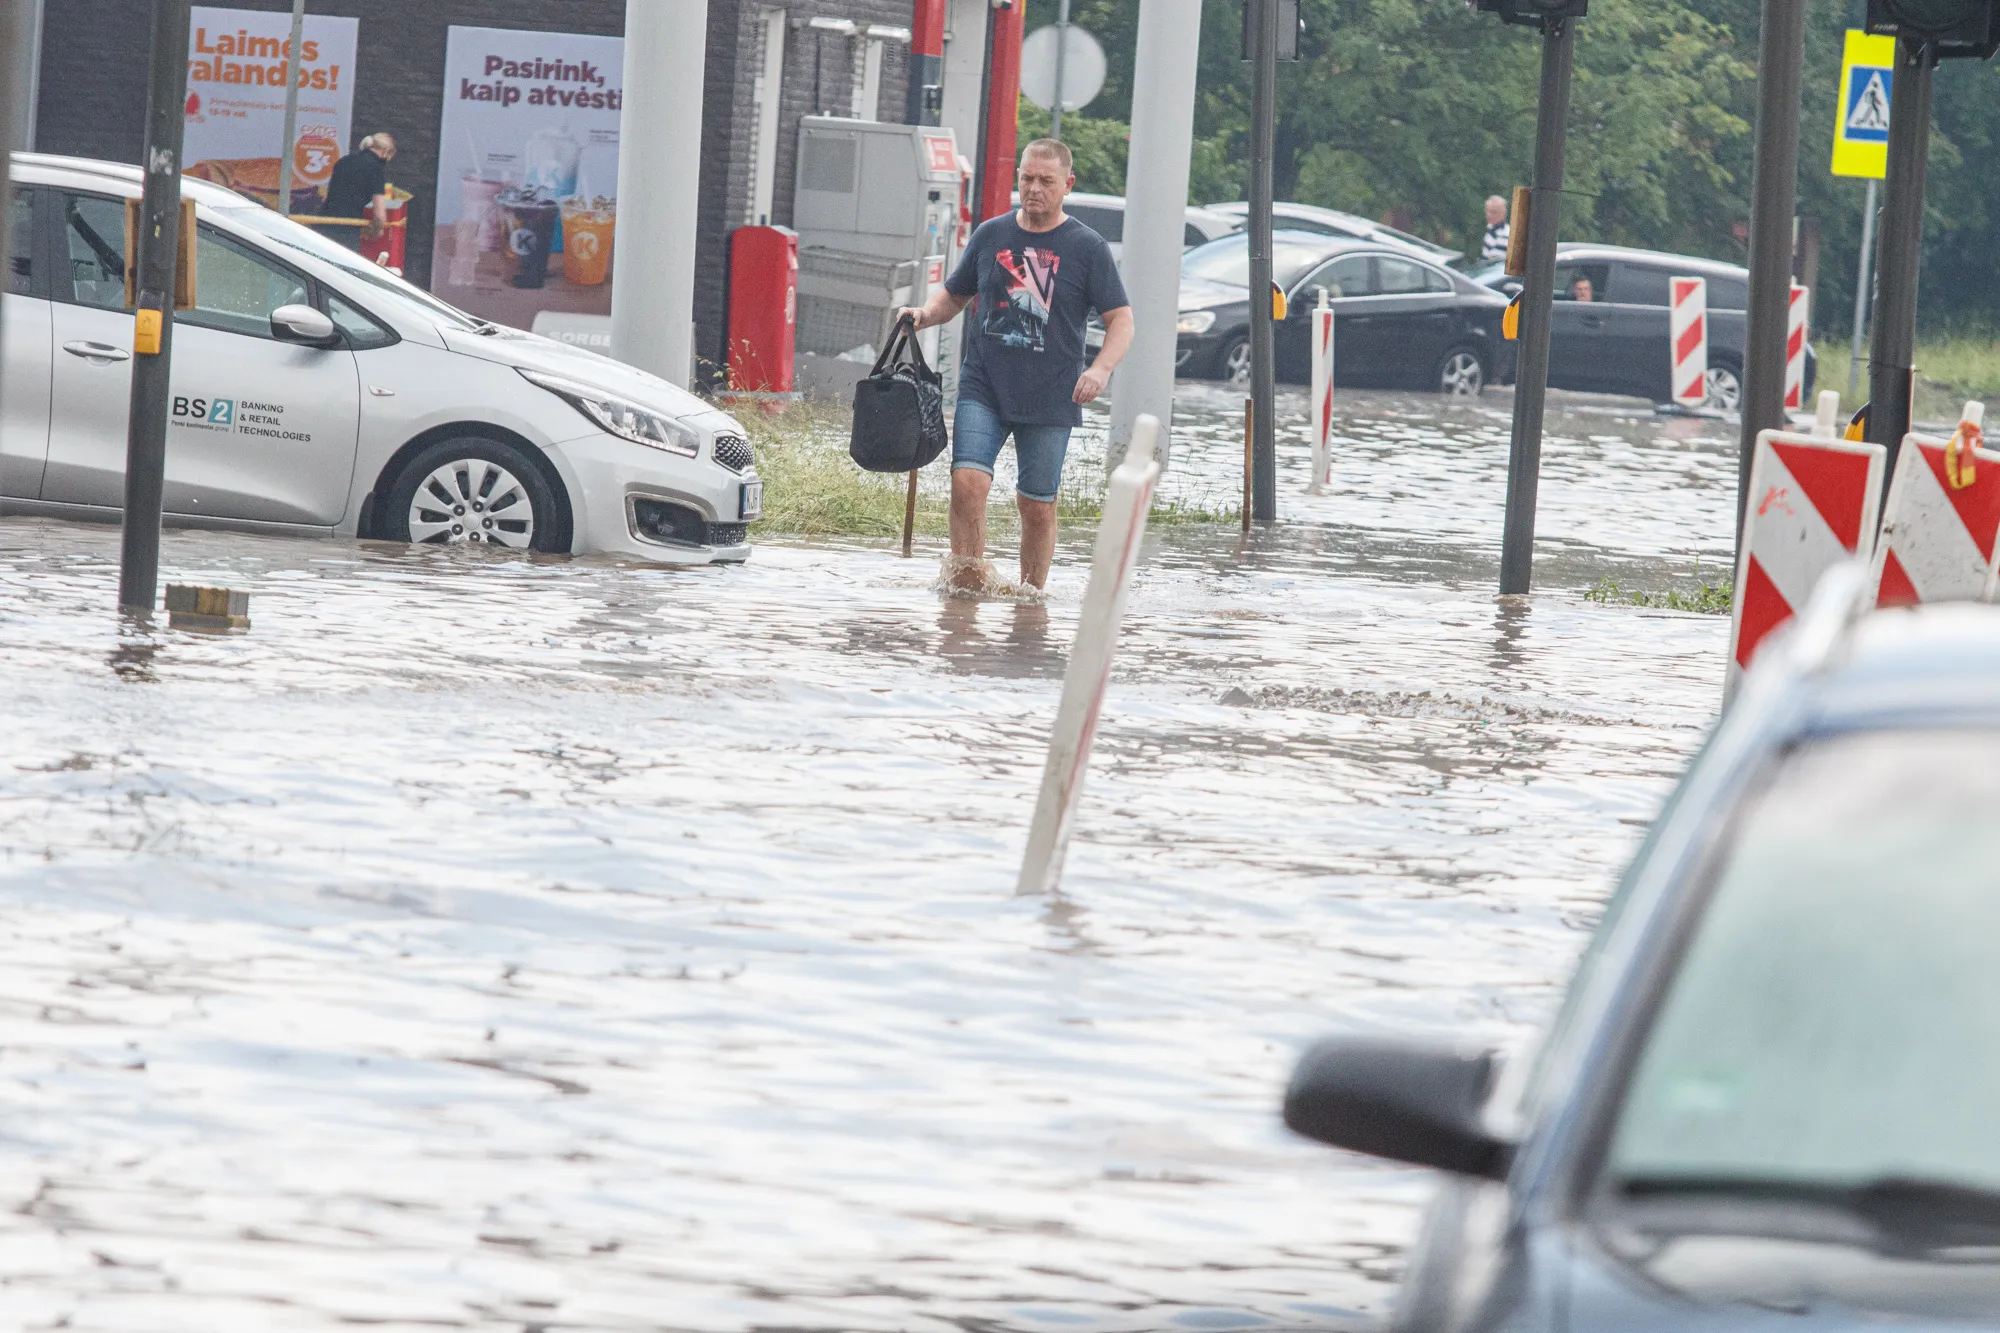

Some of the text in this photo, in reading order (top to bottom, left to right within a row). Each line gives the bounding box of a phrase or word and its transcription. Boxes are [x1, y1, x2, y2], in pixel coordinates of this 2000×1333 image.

[484, 55, 605, 87] Pasirink,
[460, 78, 521, 107] kaip
[241, 401, 284, 413] BANKING
[249, 414, 281, 426] RETAIL
[239, 426, 311, 442] TECHNOLOGIES
